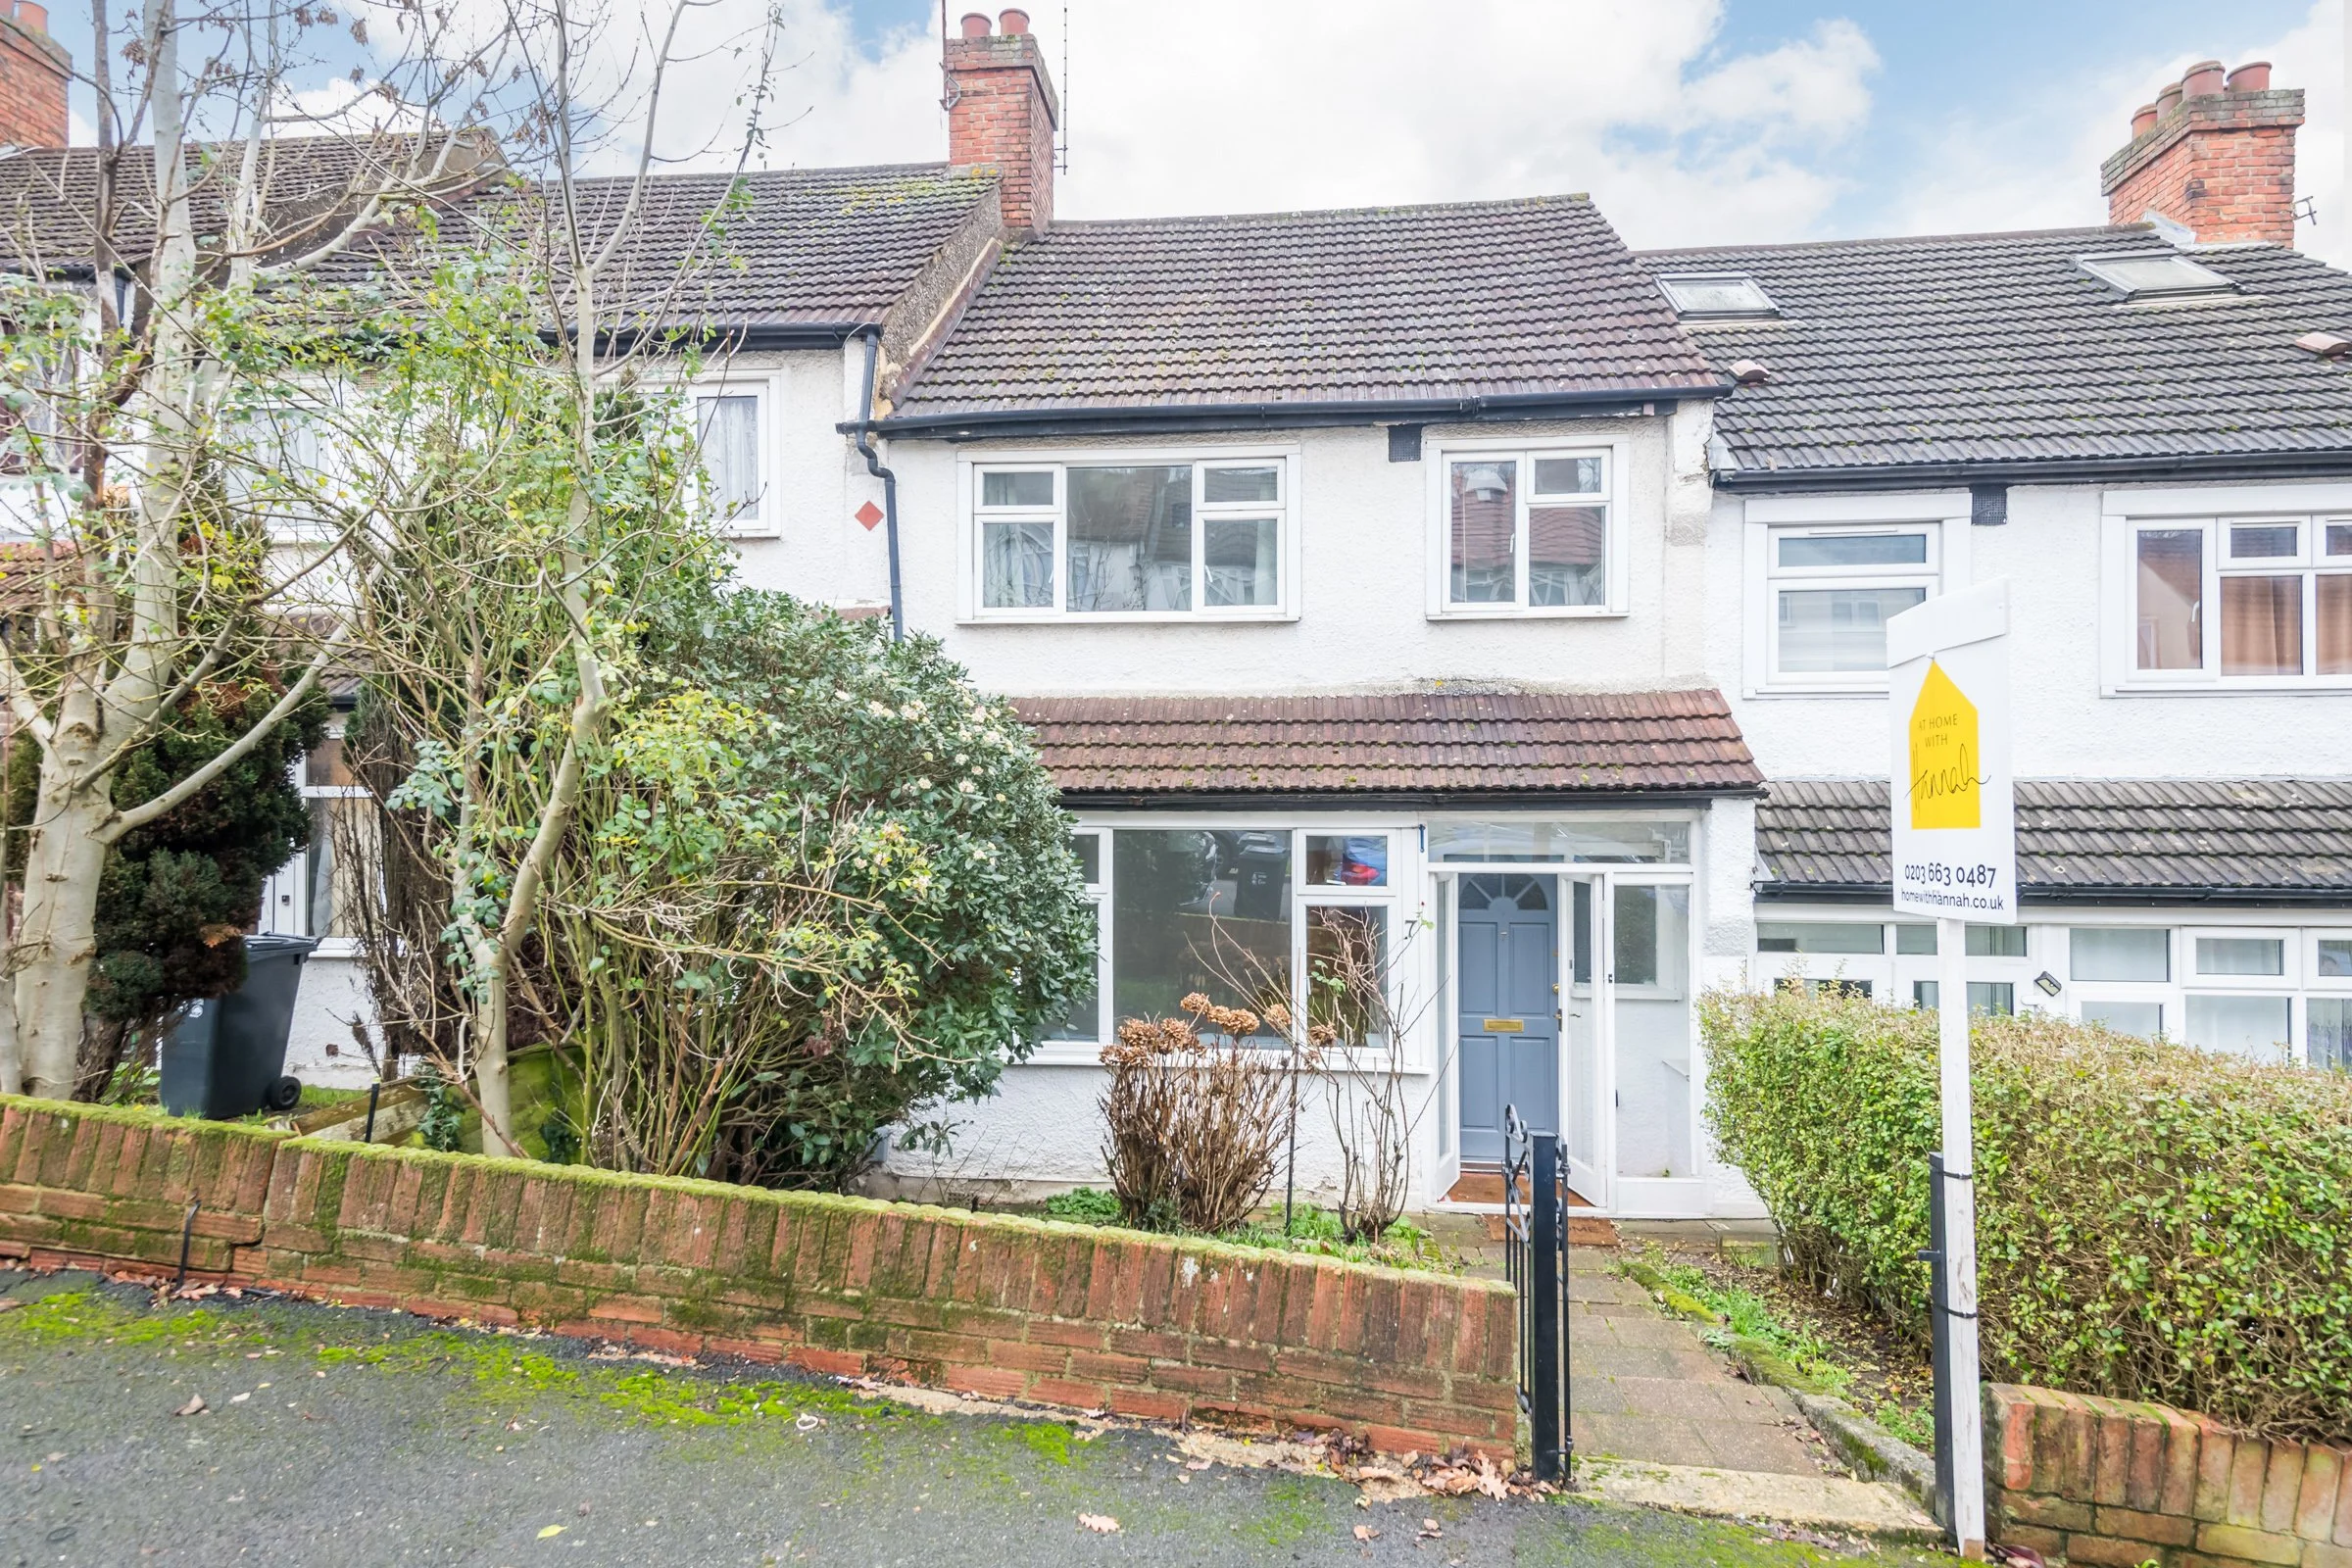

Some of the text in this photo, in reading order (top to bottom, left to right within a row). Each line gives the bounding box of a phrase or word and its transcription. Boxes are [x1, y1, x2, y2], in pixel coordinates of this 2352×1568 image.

[1918, 713, 1958, 731] AT HOME
[1924, 734, 1948, 748] WITH
[1904, 743, 1991, 819] Hannah
[1905, 862, 1996, 888] 0203 663 0487
[1404, 919, 1418, 938] 7
